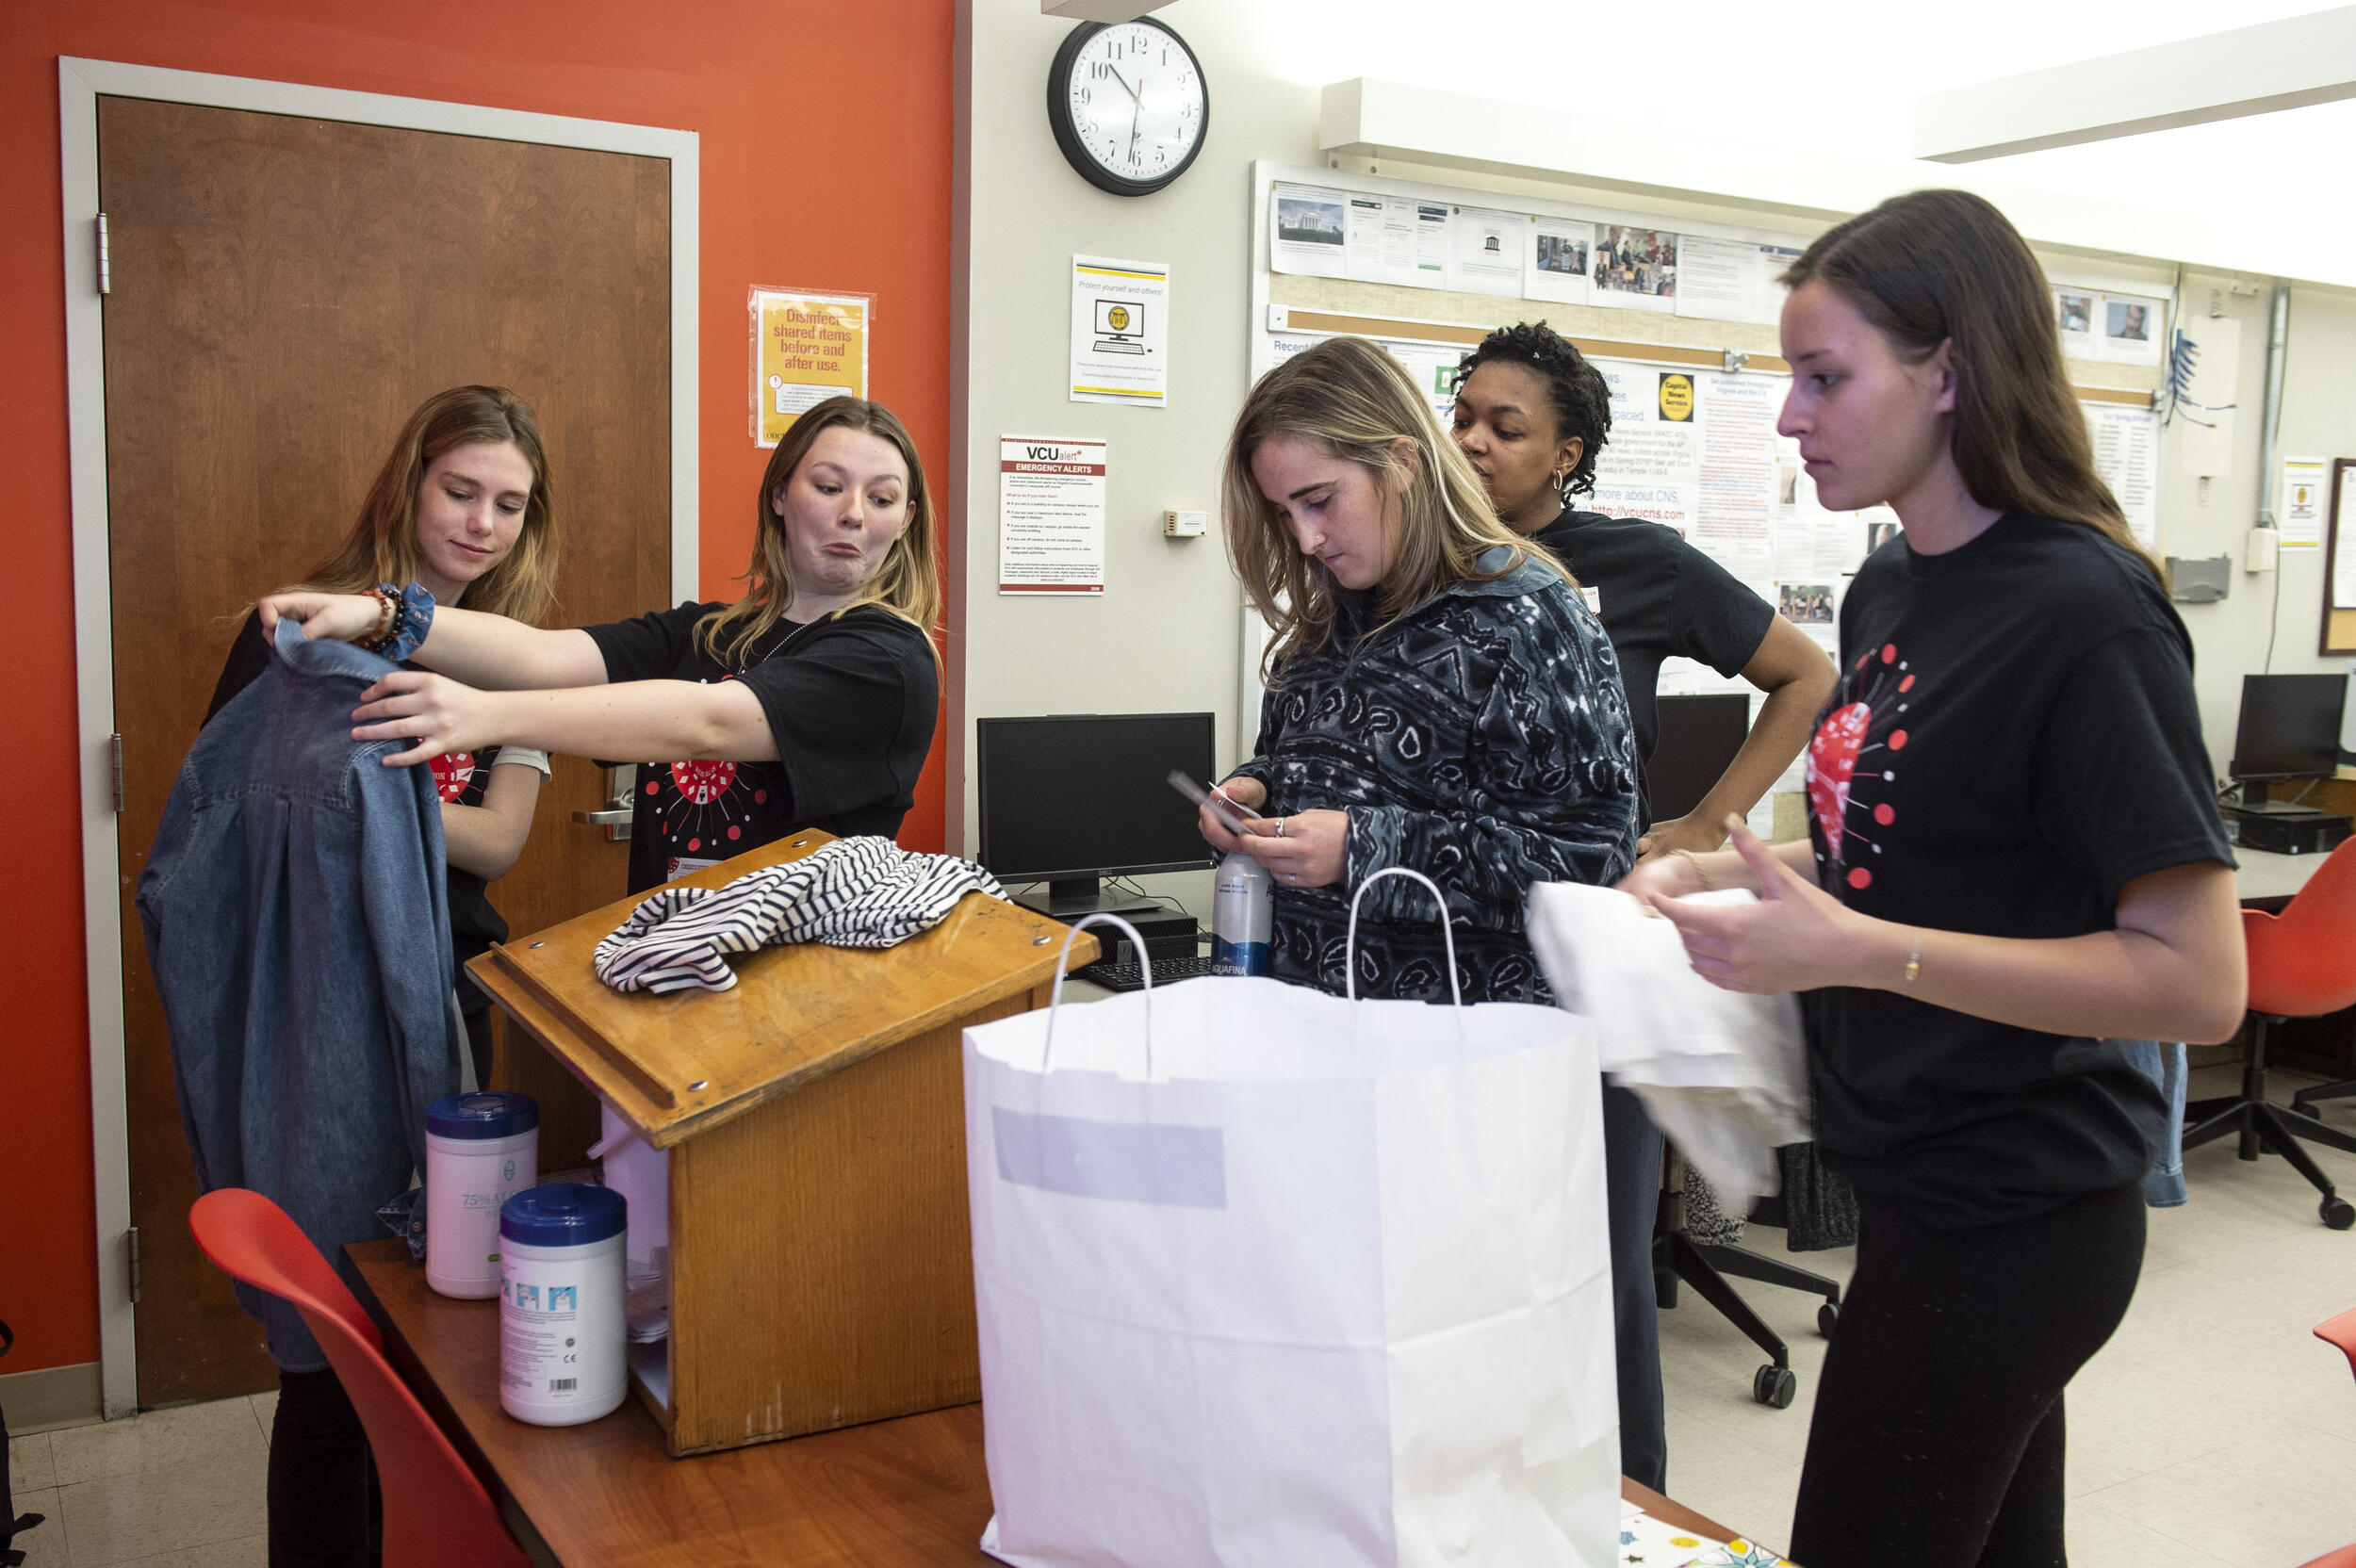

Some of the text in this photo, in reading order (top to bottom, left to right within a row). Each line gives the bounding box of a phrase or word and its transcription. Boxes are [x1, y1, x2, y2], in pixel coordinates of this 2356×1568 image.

[1107, 41, 1121, 59] 11
[1131, 36, 1148, 54] 12
[1162, 50, 1167, 66] 1
[1091, 61, 1108, 80] 10
[1178, 74, 1186, 90] 2
[1081, 87, 1090, 106] 9
[1182, 104, 1191, 118] 3
[1088, 116, 1099, 134] 8
[1174, 126, 1183, 142] 4
[1108, 139, 1117, 157] 7
[1155, 145, 1165, 163] 5
[1132, 150, 1141, 167] 6
[1078, 280, 1101, 289] Protect
[1102, 284, 1127, 293] yourself
[774, 324, 852, 342] shared items
[781, 339, 845, 356] before and
[785, 355, 841, 372] after use.
[1665, 381, 1688, 390] Capital
[1016, 463, 1092, 474] EMERGENCY ALERTS
[1595, 489, 1622, 500] more
[1625, 490, 1654, 502] about
[1591, 504, 1685, 520] http://vcucns.com
[1212, 964, 1248, 976] AQUAFINA
